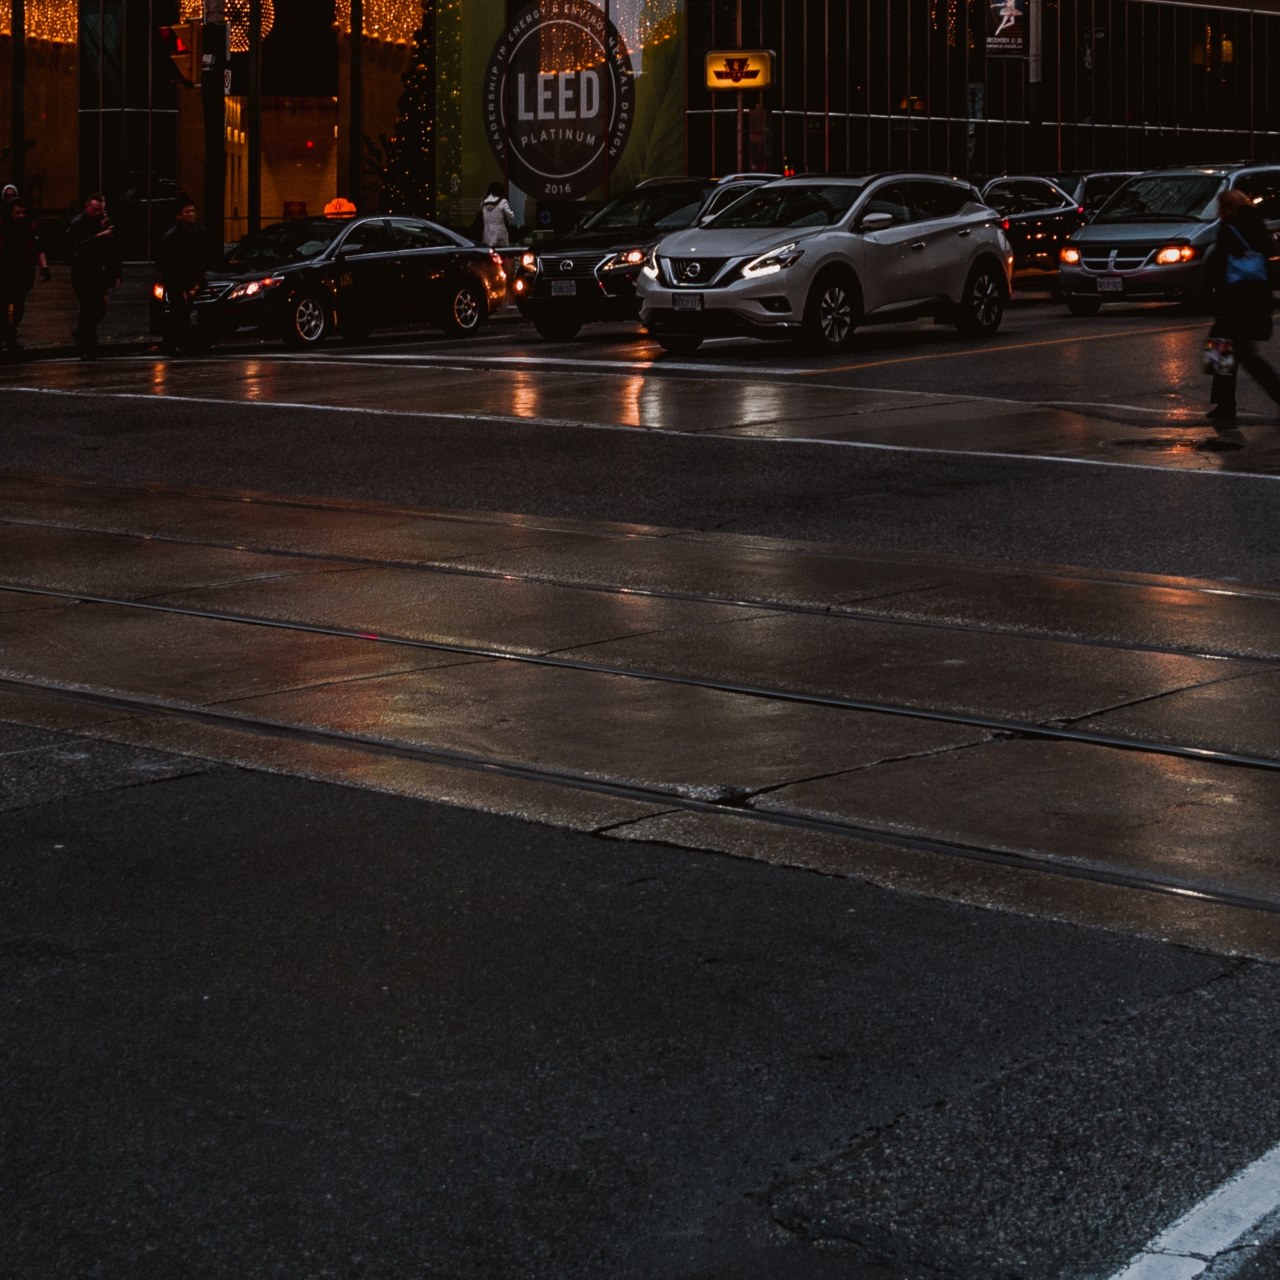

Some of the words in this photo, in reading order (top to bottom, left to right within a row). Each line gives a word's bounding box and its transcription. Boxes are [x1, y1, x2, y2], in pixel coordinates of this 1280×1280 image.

[496, 46, 507, 62] IN
[564, 4, 629, 94] ENVIROMENTAL
[608, 101, 629, 157] DESIGN
[517, 70, 600, 120] LEED
[521, 128, 596, 148] PLATINUM
[545, 183, 572, 195] 2016
